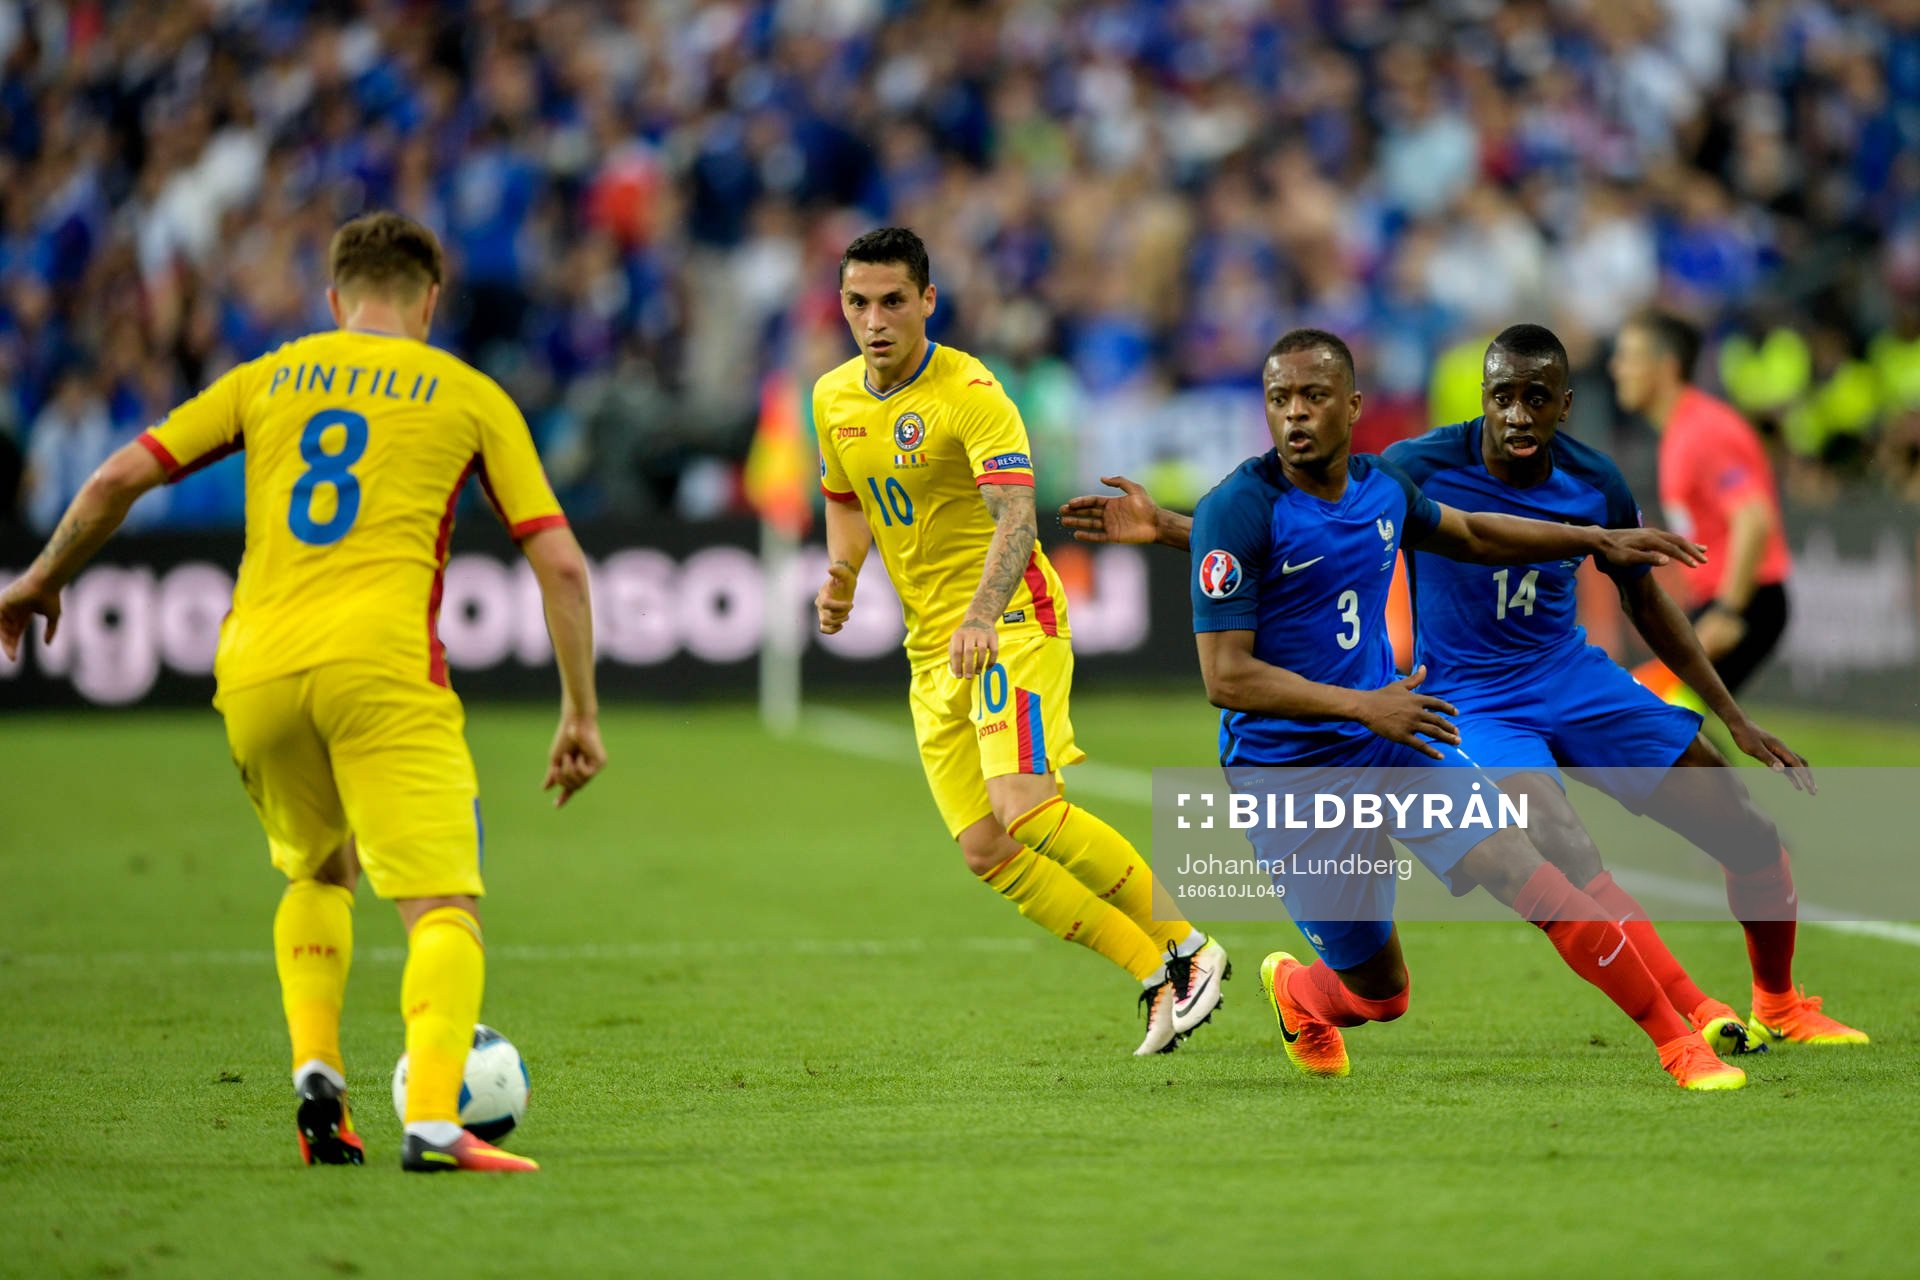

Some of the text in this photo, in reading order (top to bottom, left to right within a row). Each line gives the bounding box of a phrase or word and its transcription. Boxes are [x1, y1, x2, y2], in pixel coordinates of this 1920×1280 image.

[269, 363, 438, 403] PINTILII
[288, 408, 369, 546] 8
[867, 476, 914, 527] 10
[1336, 589, 1361, 650] 3
[1493, 568, 1540, 620] 14
